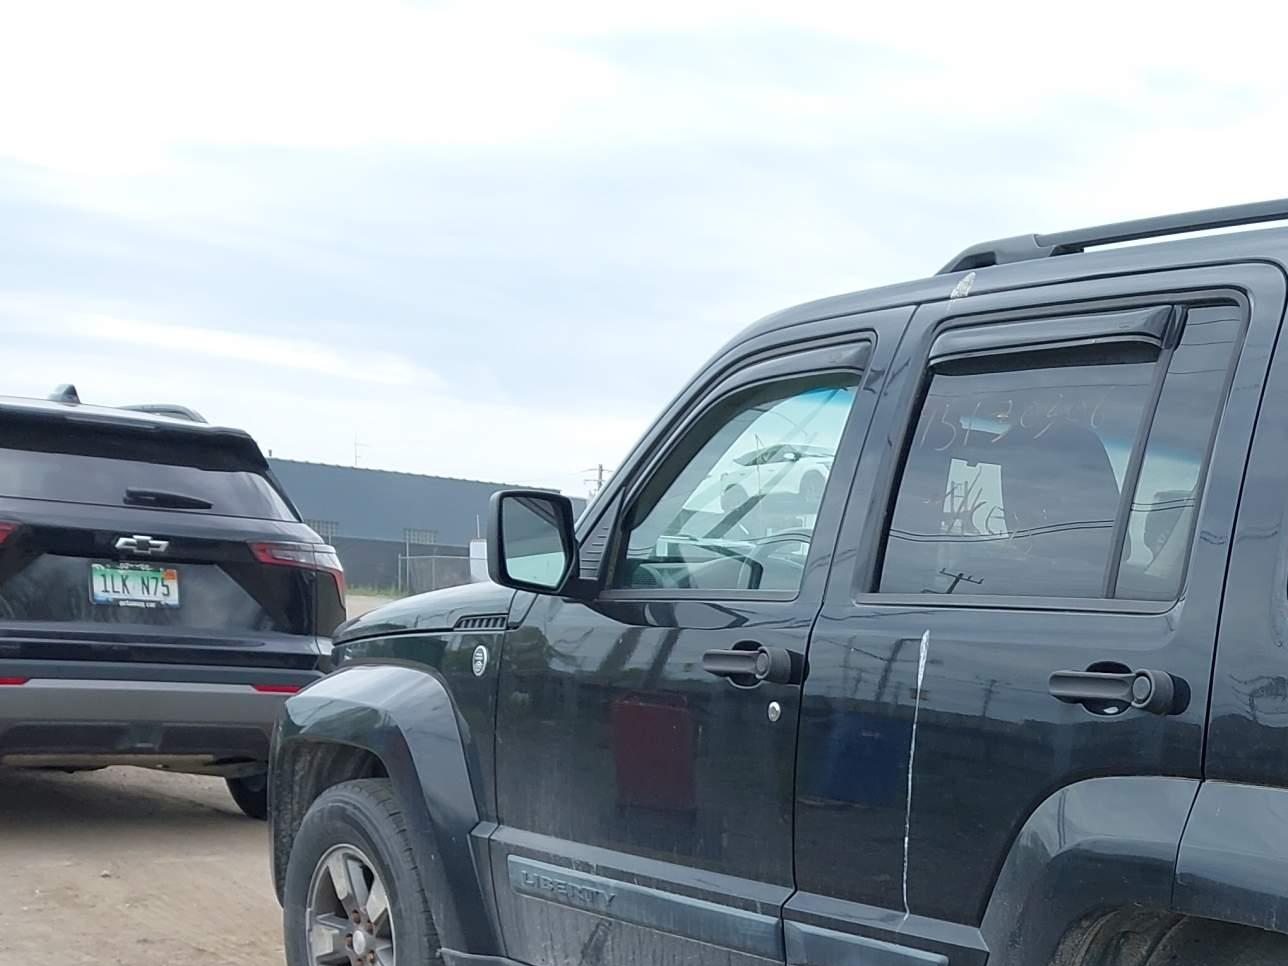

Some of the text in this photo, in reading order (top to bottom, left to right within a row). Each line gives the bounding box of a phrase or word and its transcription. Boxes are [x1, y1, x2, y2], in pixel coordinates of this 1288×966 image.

[100, 573, 170, 597] 1LK N75
[521, 870, 616, 908] LIBERTY
